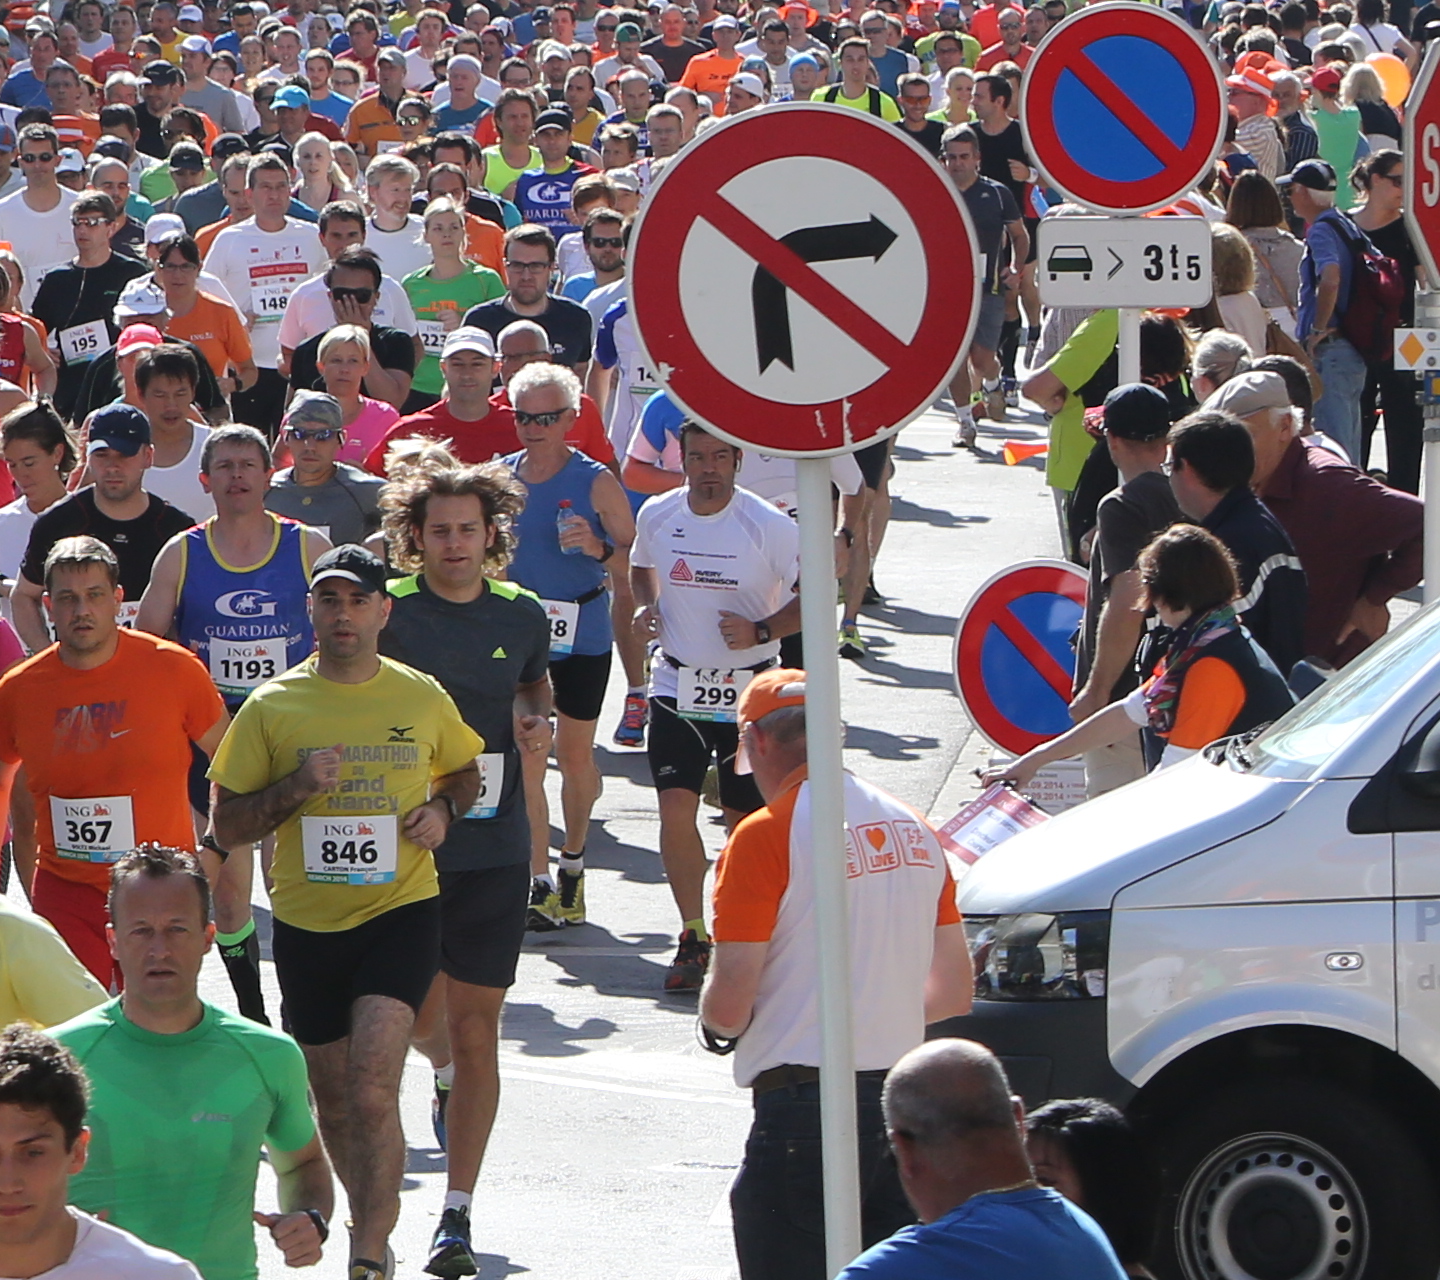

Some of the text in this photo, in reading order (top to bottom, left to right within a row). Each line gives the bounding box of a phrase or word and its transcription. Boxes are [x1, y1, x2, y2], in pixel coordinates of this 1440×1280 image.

[263, 287, 281, 296] ING
[71, 335, 98, 353] 195
[695, 570, 722, 578] AVERY
[695, 577, 738, 587] DENNISON
[204, 622, 290, 636] GUARDIAN
[227, 646, 252, 658] ING
[220, 659, 276, 680] 1193
[692, 686, 737, 707] 299
[339, 744, 419, 764] MARATHON
[64, 805, 91, 817] ING
[327, 794, 399, 812] Nancy
[65, 820, 112, 844] 367
[324, 823, 353, 836] ING
[321, 839, 379, 864] 846
[870, 851, 896, 868] LOVE
